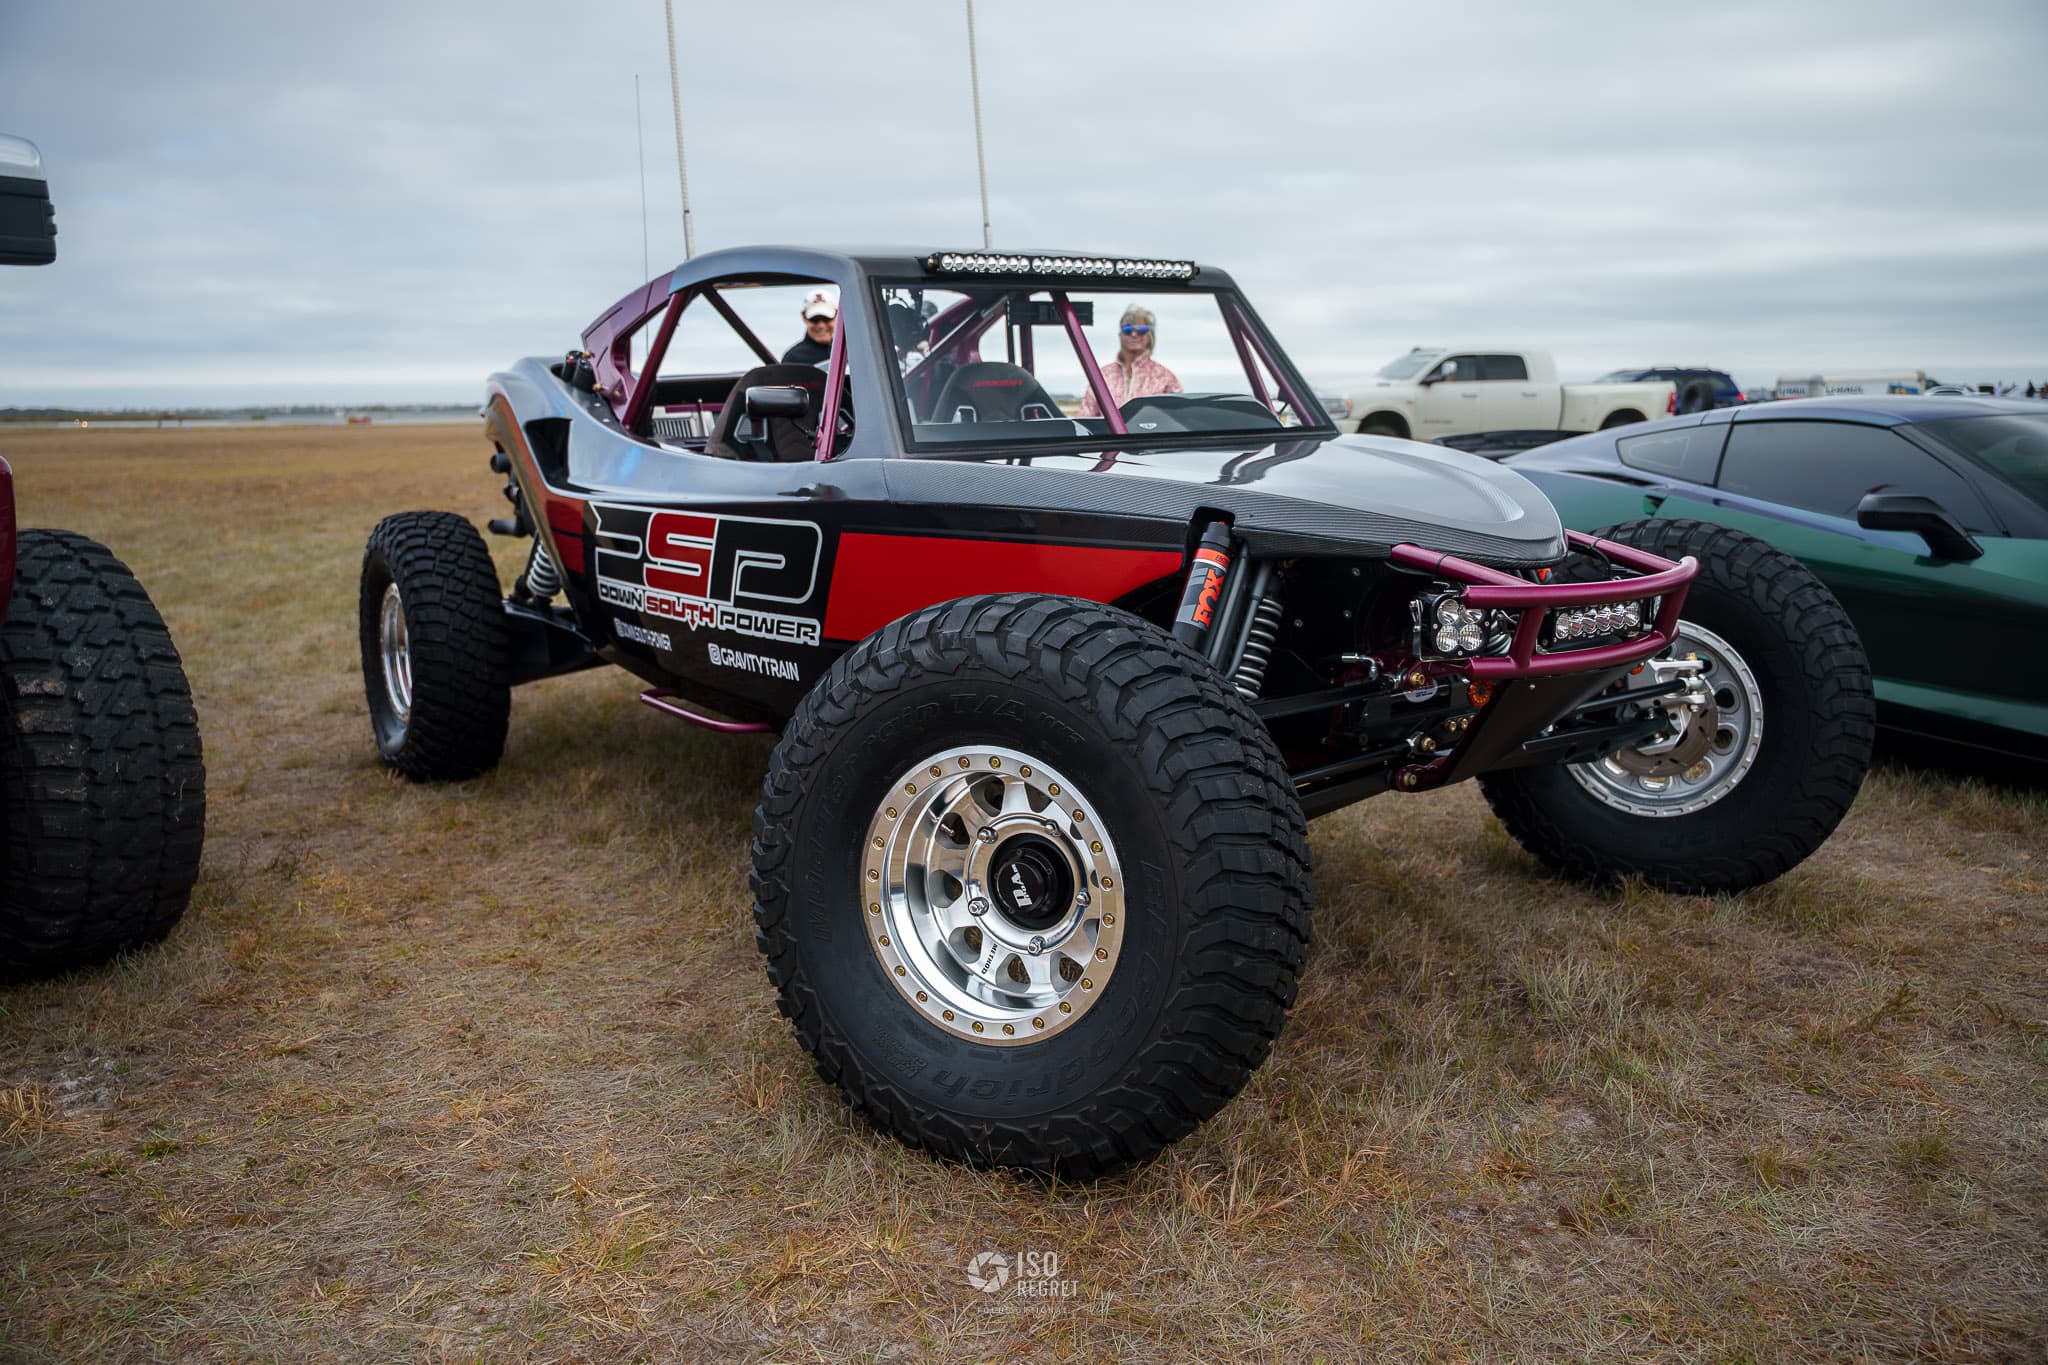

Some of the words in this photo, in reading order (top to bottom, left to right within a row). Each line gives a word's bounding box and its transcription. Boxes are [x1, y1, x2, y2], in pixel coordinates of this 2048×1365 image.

[589, 500, 824, 606] DSP
[598, 581, 645, 612] DOWN
[645, 591, 717, 631] SOUTH
[717, 605, 821, 647] POWER
[1191, 567, 1226, 629] FOX
[980, 943, 998, 975] METHOD
